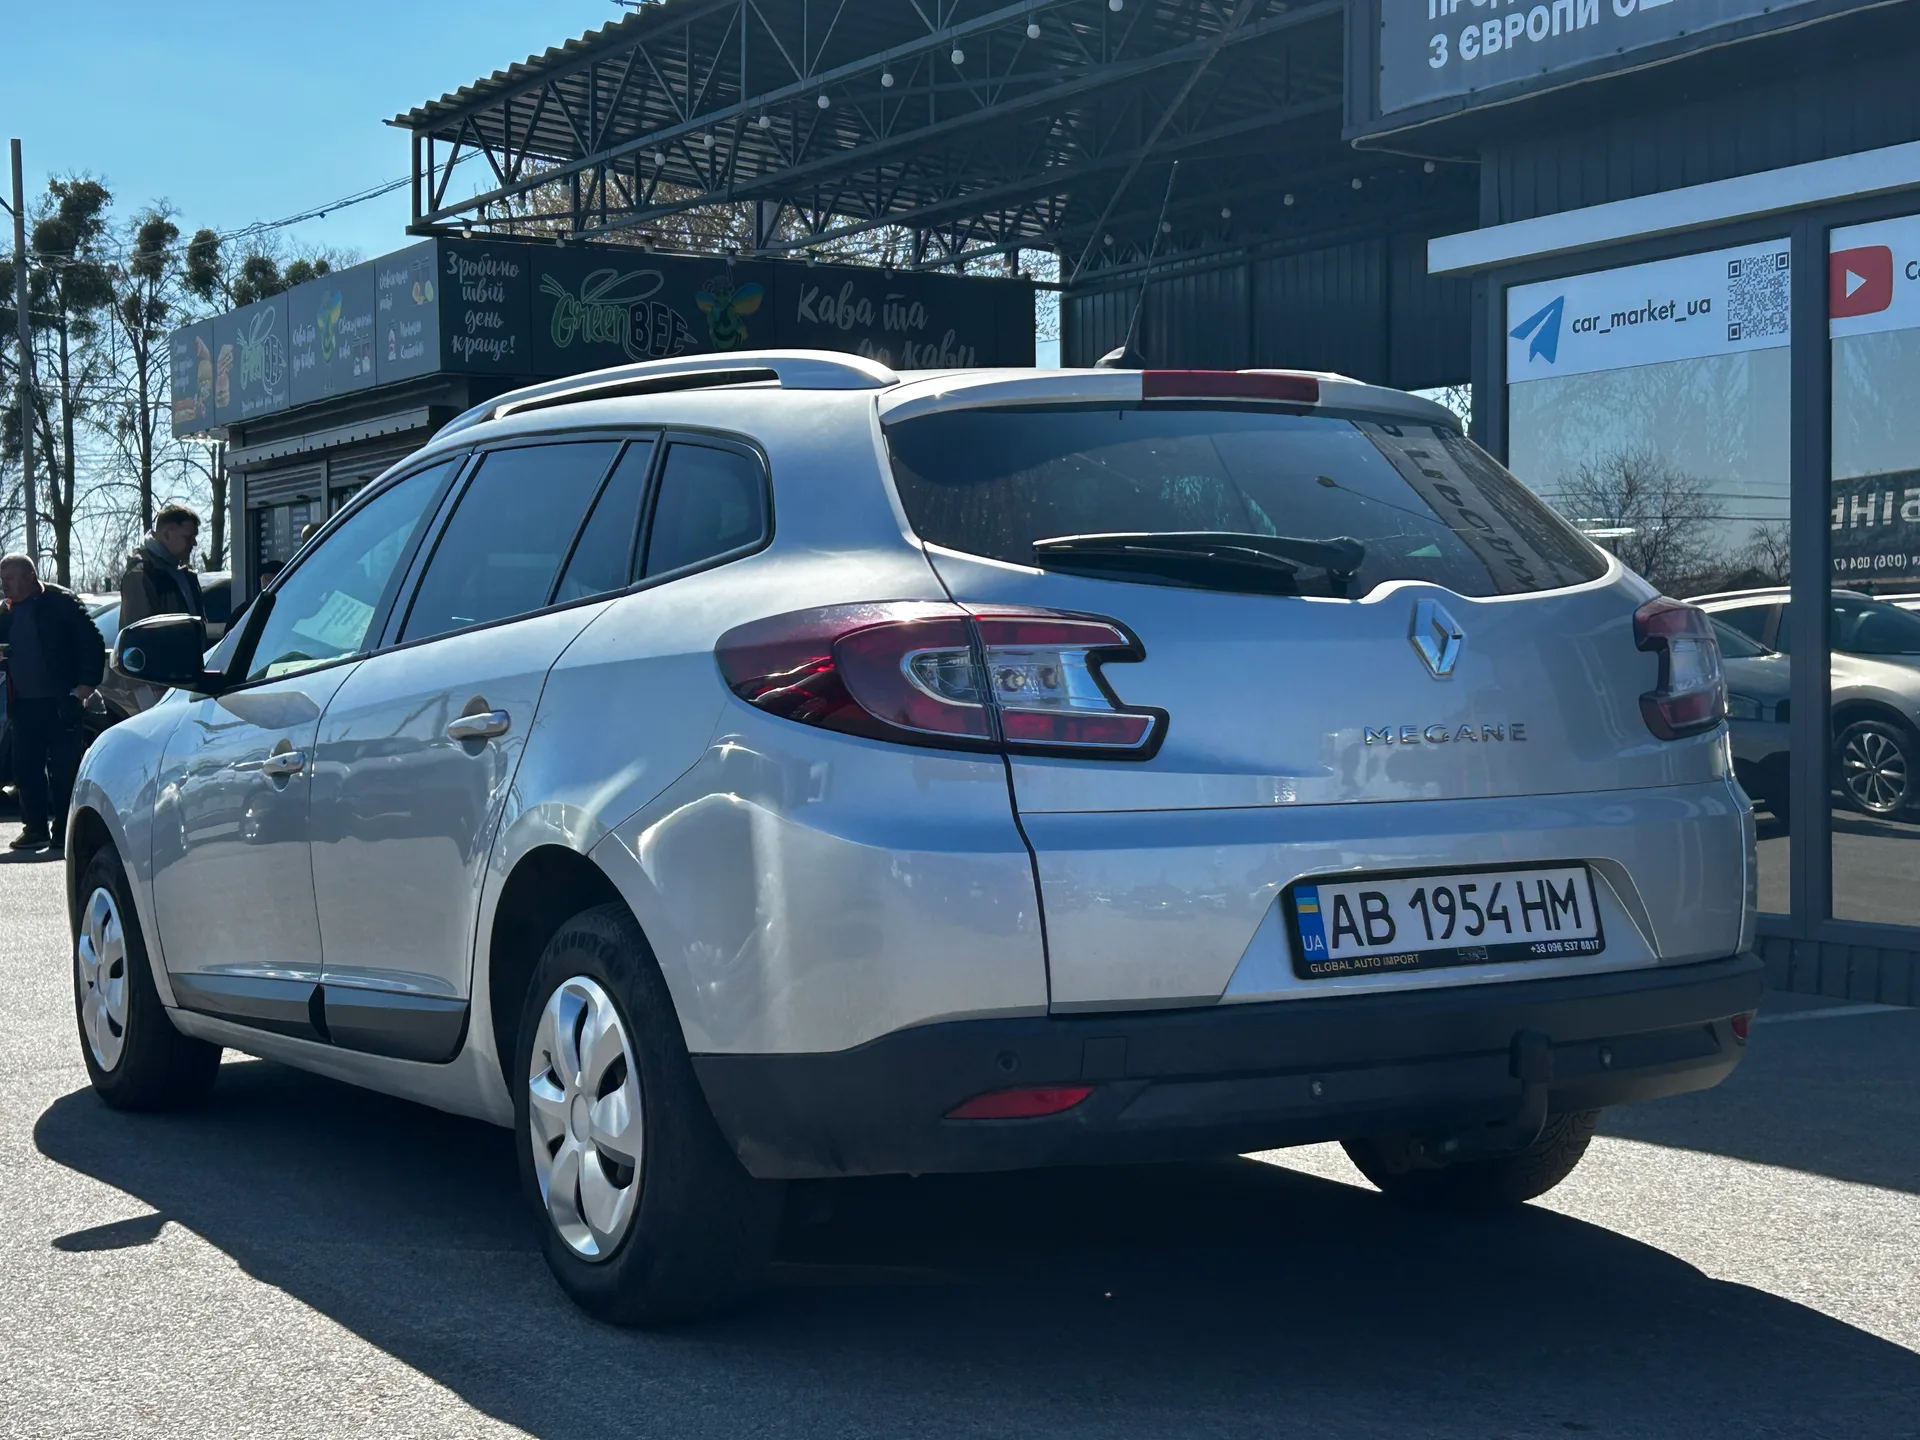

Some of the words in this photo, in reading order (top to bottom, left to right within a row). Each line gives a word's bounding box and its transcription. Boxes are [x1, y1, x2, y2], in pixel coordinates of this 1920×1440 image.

[1458, 0, 1600, 61] ЄВРОПИ
[461, 277, 506, 303] твій
[797, 280, 876, 331] Кава
[883, 293, 929, 332] та
[1571, 295, 1712, 336] car_market_ua
[464, 309, 504, 334] день
[450, 335, 516, 363] краще!
[1363, 722, 1528, 745] MEGANE
[1331, 891, 1396, 949] AB
[1408, 881, 1512, 941] 1954
[1516, 877, 1582, 932] HM
[1303, 934, 1325, 952] UA
[1309, 959, 1353, 973] GLOBAL
[1354, 957, 1381, 969] AUTO
[1383, 954, 1420, 966] IMPORT
